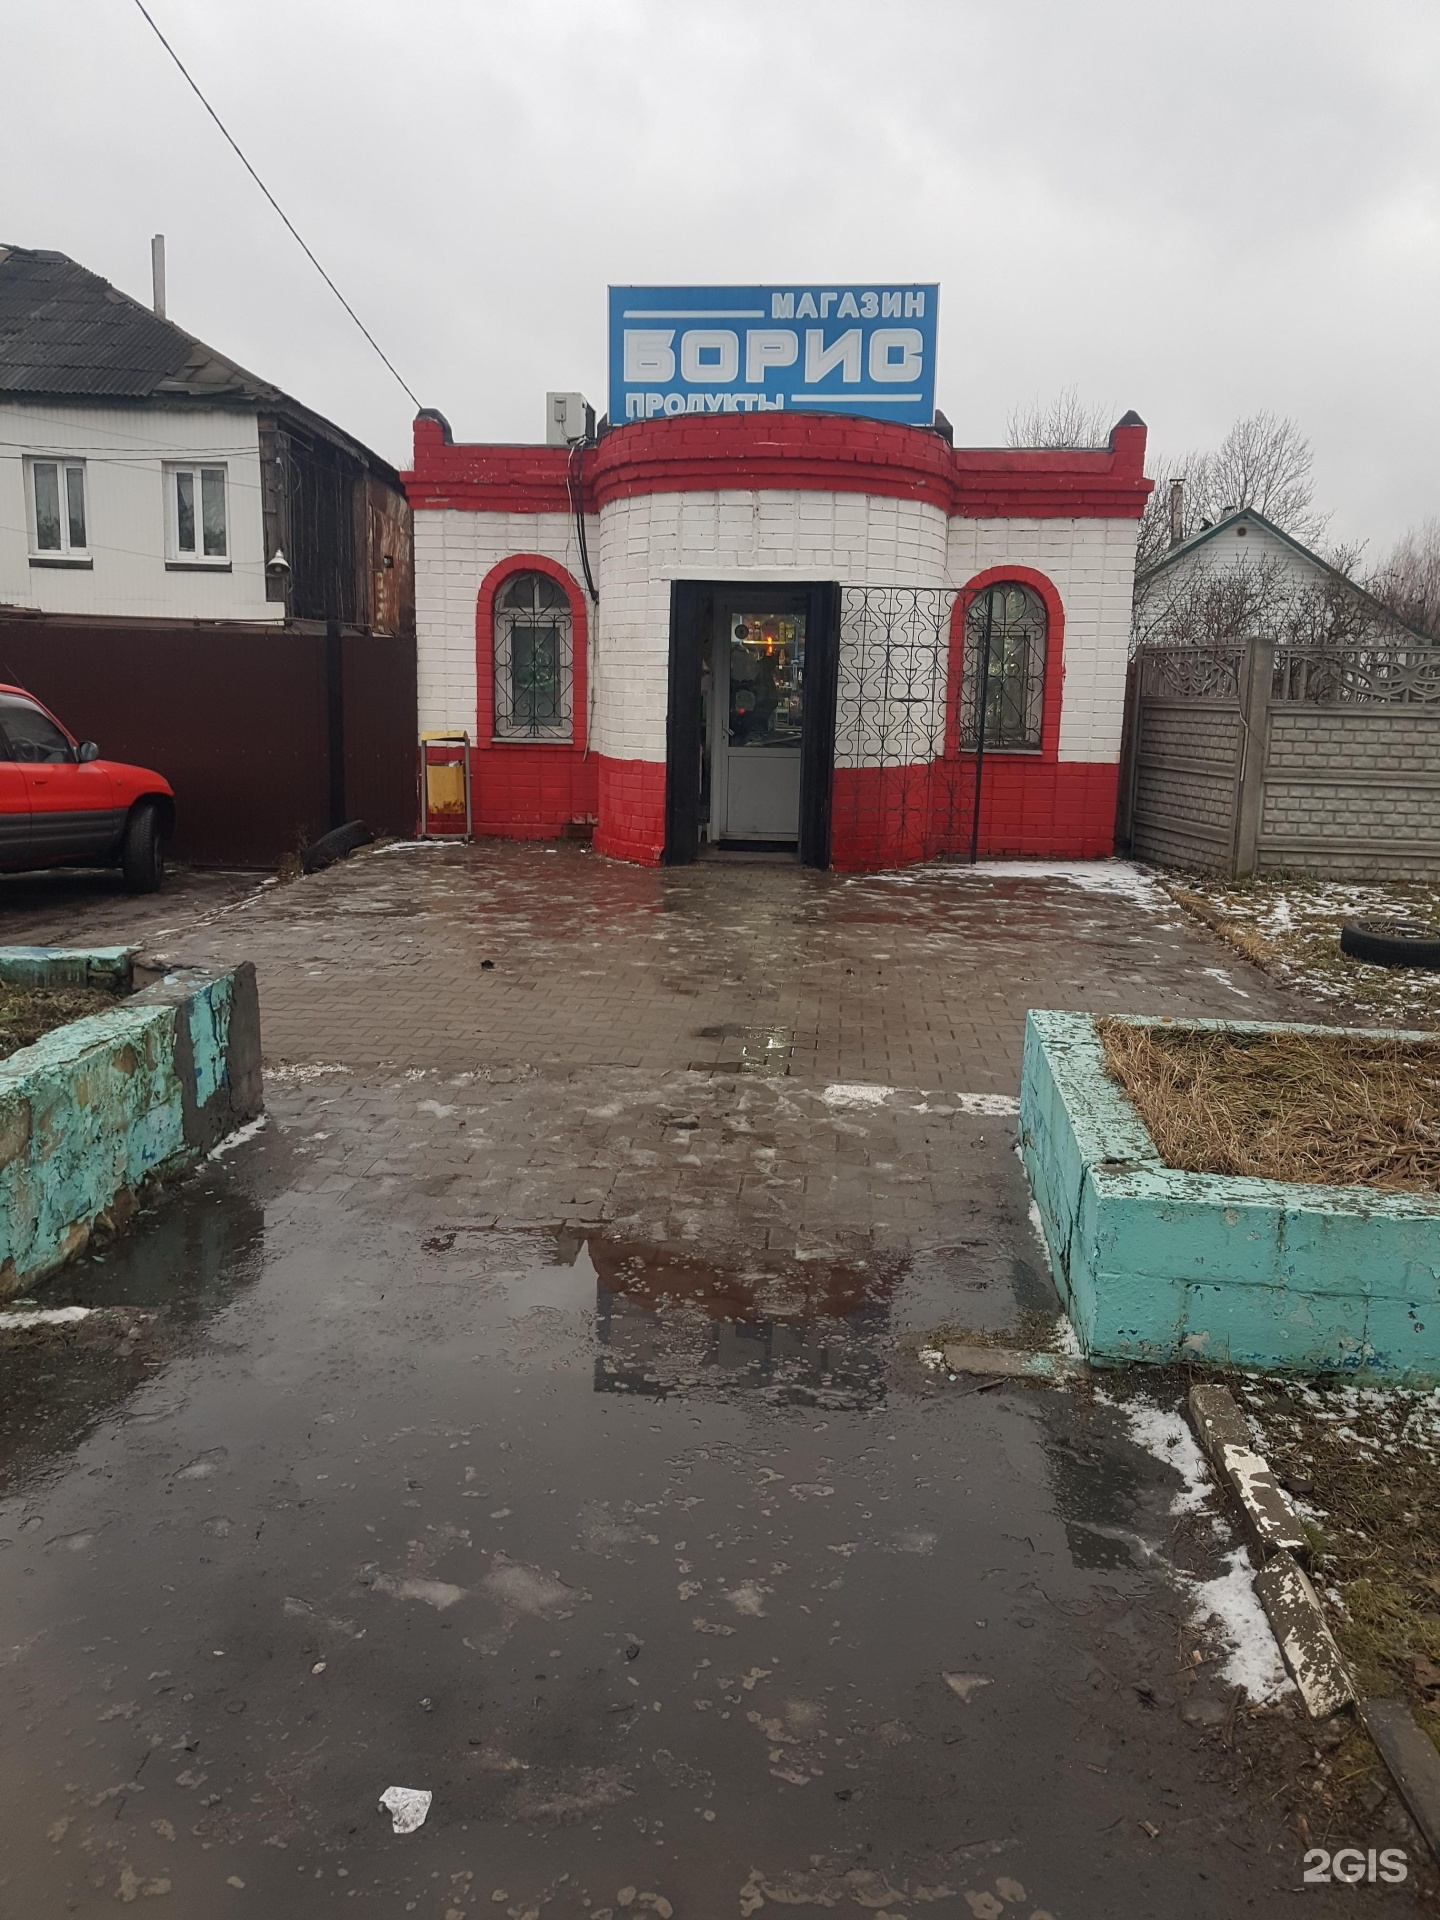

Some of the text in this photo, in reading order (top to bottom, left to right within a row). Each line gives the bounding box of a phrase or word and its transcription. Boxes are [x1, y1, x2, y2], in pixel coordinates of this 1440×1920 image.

[771, 292, 925, 319] МАГАЗИН
[623, 328, 924, 383] БОРИС
[625, 393, 784, 418] ПРОДУКТЫ
